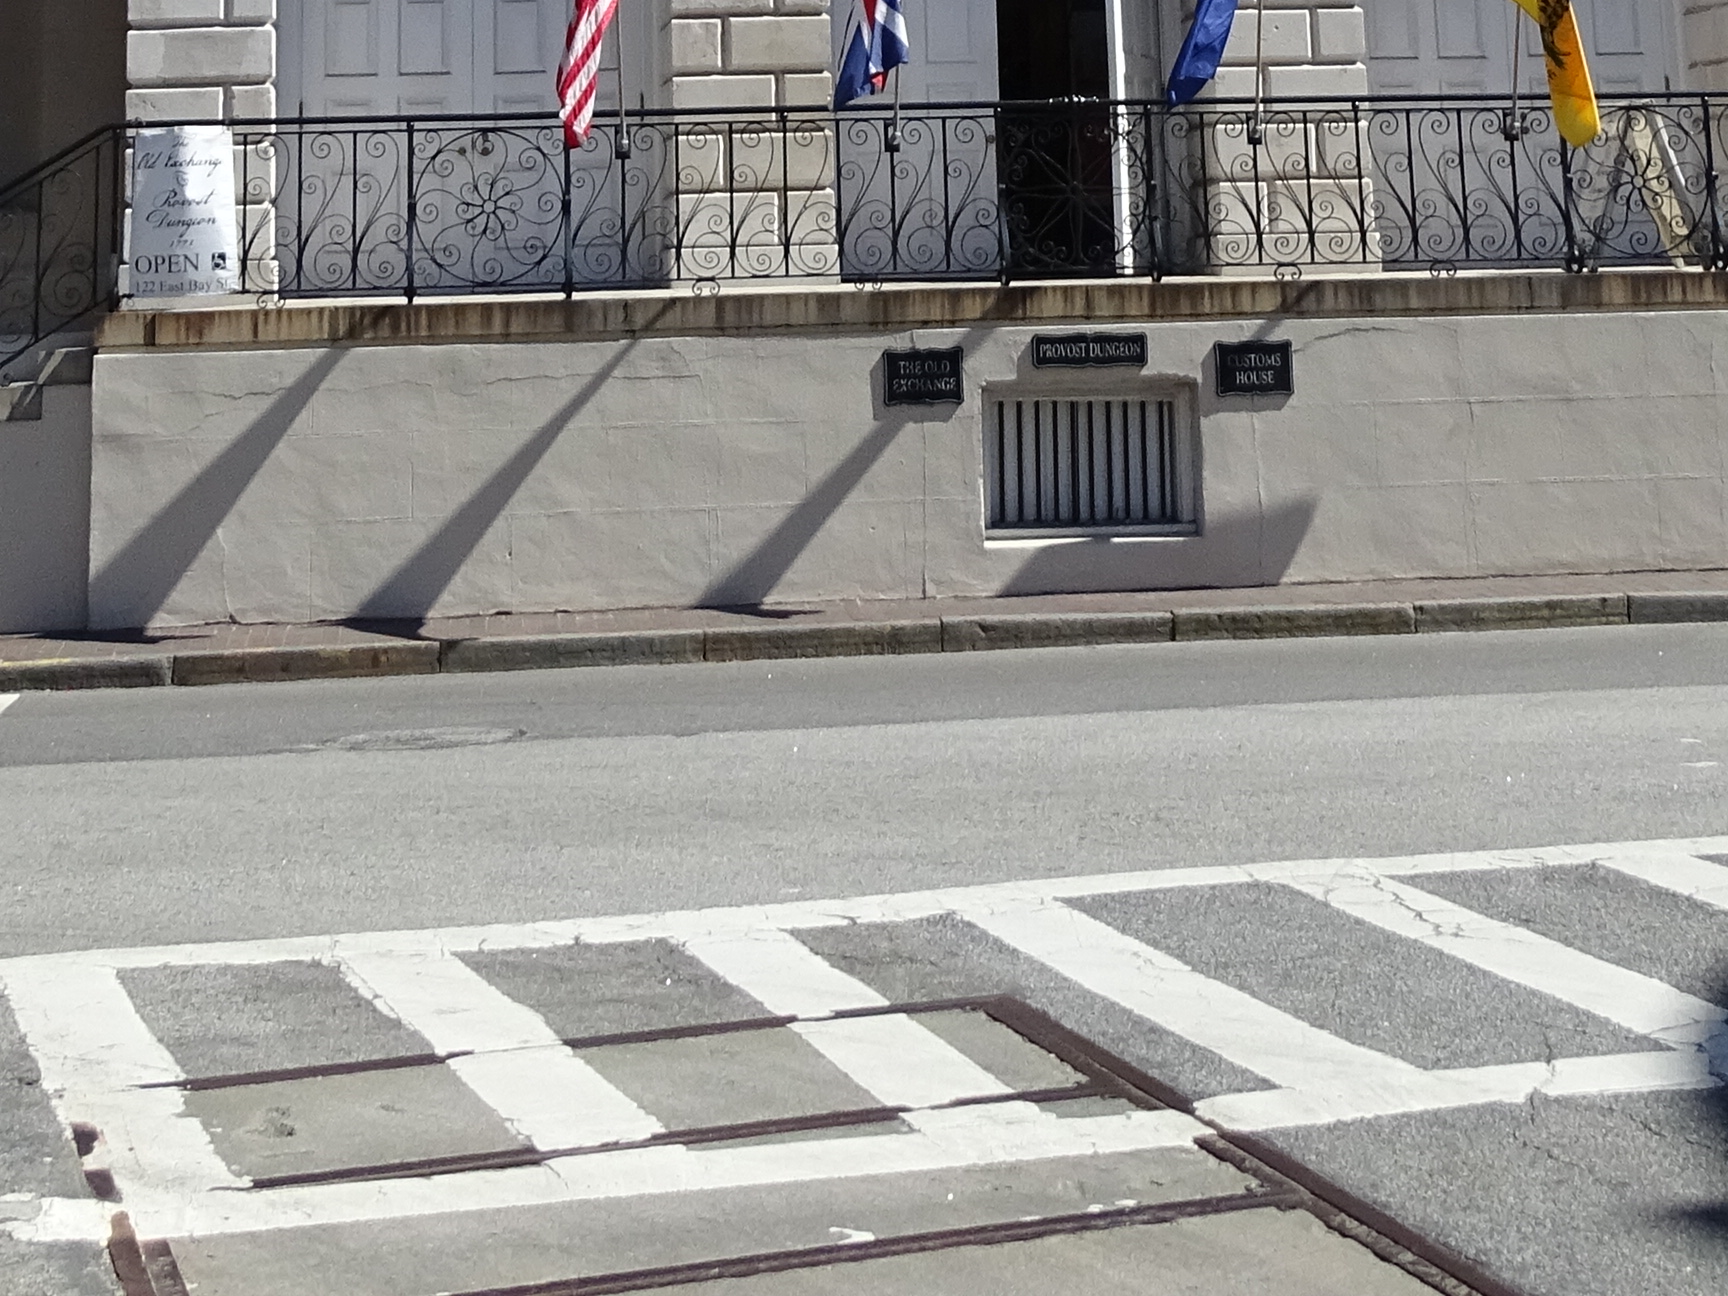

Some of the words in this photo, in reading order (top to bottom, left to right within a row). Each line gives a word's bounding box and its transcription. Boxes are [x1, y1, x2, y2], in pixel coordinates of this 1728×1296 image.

[153, 188, 216, 208] Provost
[145, 209, 216, 238] Dungeon
[134, 253, 200, 275] OPEN
[136, 280, 156, 293] 122
[159, 280, 184, 292] East
[188, 279, 211, 293] Bay
[1039, 343, 1086, 358] PROVOST
[1089, 341, 1141, 357] DUNGEON
[898, 360, 922, 375] THE
[925, 360, 950, 374] OLD
[1228, 353, 1281, 368] CUSTOMS
[893, 377, 957, 392] EXCHANGE
[1236, 370, 1275, 385] HOUSE
